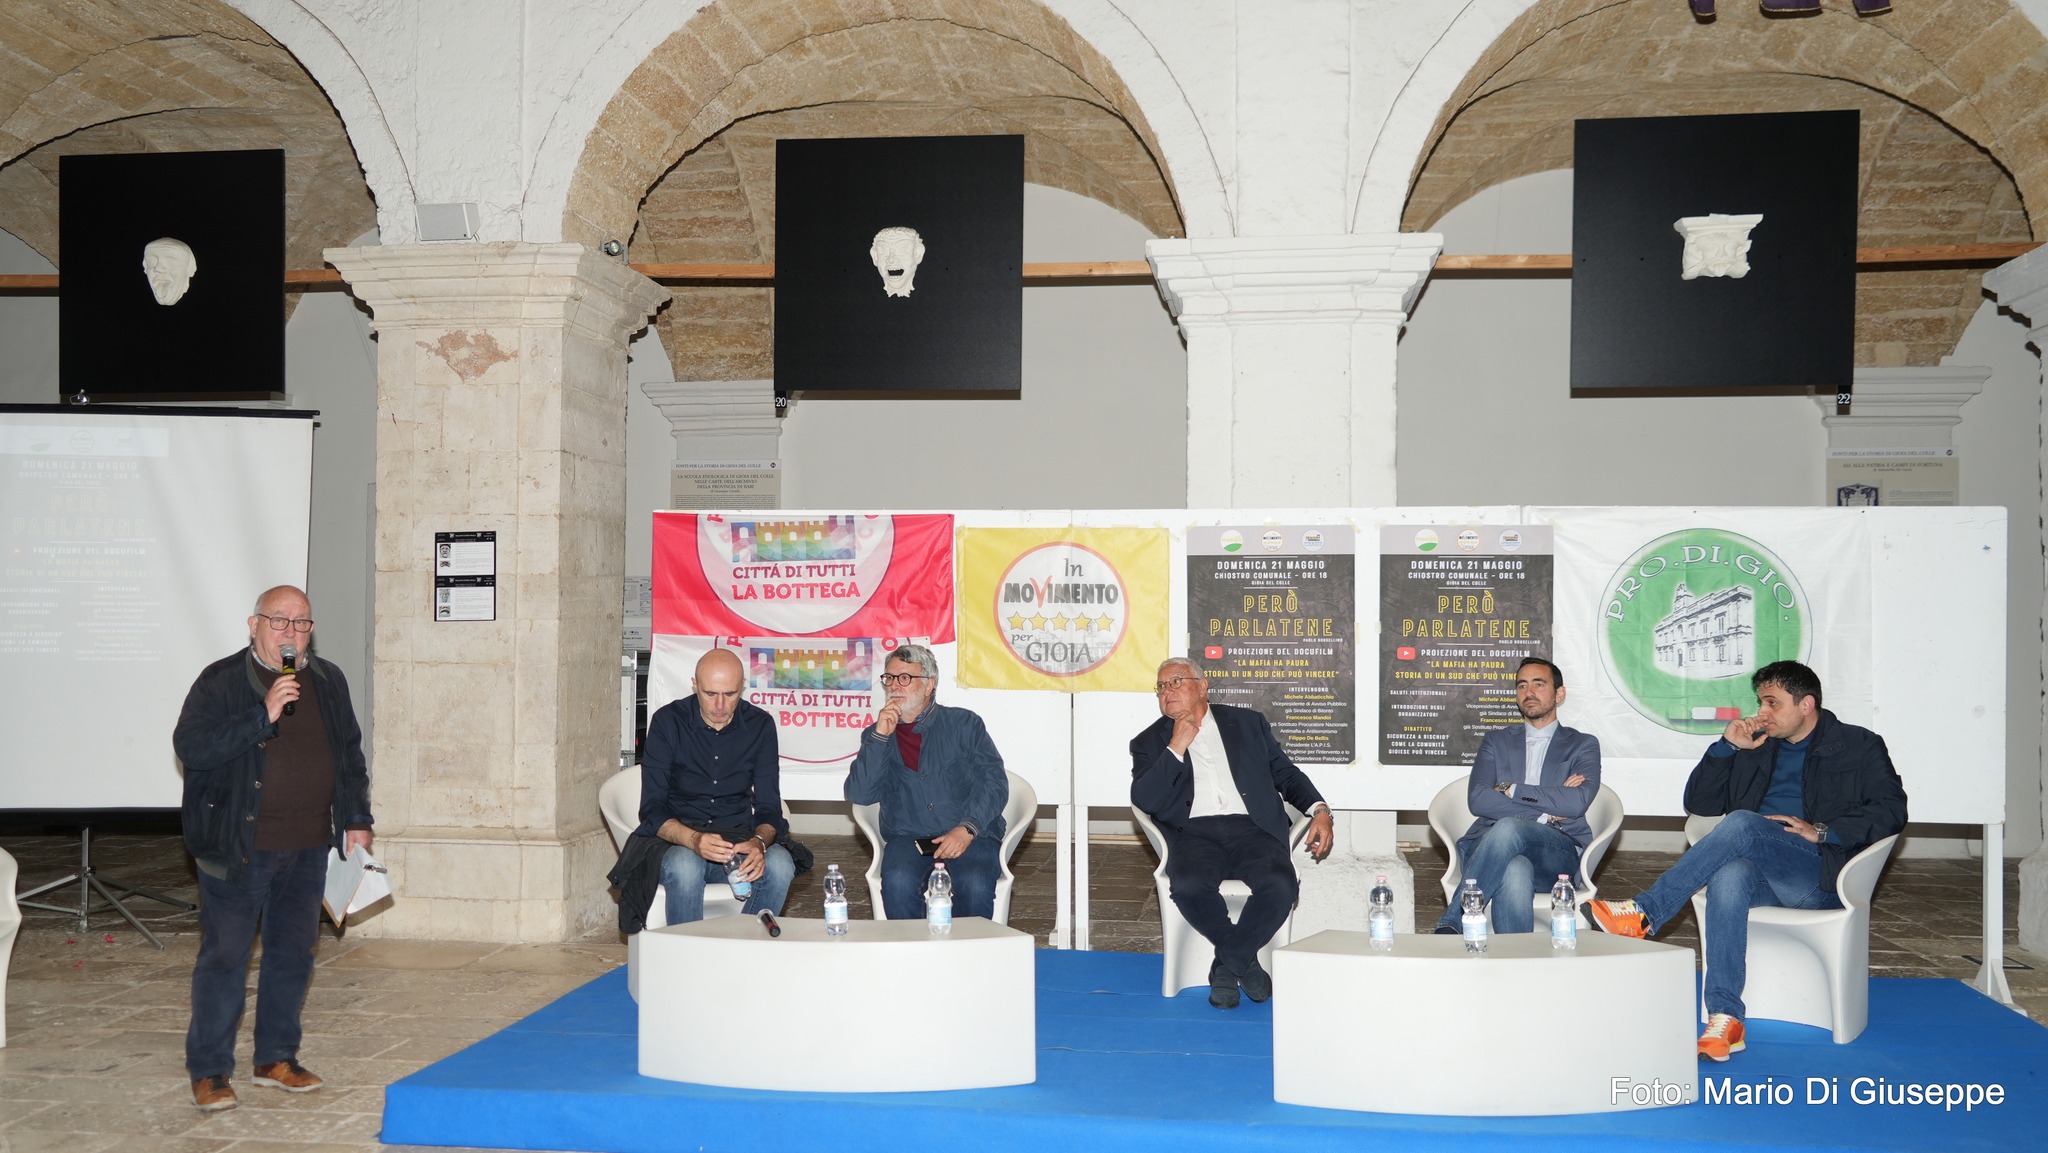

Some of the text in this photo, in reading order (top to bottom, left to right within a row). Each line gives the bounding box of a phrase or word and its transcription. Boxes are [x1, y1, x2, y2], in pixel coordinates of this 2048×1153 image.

[775, 397, 787, 407] 20
[1837, 393, 1851, 404] 22
[785, 565, 803, 578] DI
[806, 564, 856, 578] TUTTI
[1217, 560, 1325, 570] DOMENICA 21 MAGGIO
[1411, 561, 1523, 570] DOMENICA 21 MAGGIO
[732, 582, 861, 600] LA BOTTEGA
[1004, 575, 1119, 608] MOVIMENTO
[1243, 589, 1298, 613] PERÒ
[1438, 590, 1494, 614] PERÒ
[1210, 618, 1333, 637] PARLATENE
[1402, 619, 1530, 638] PARLATENE
[1011, 633, 1033, 645] per
[1025, 642, 1094, 664] GIOIA
[1421, 649, 1468, 657] PROIEZIONE
[1489, 650, 1530, 658] DOCUFILM
[1288, 669, 1302, 678] PUÒ
[1395, 671, 1422, 679] STORIA
[1465, 672, 1480, 680] CHE
[1483, 671, 1498, 680] PUÒ
[802, 694, 819, 707] DI
[822, 694, 871, 708] TUTTI
[779, 711, 875, 729] BOTTEGA
